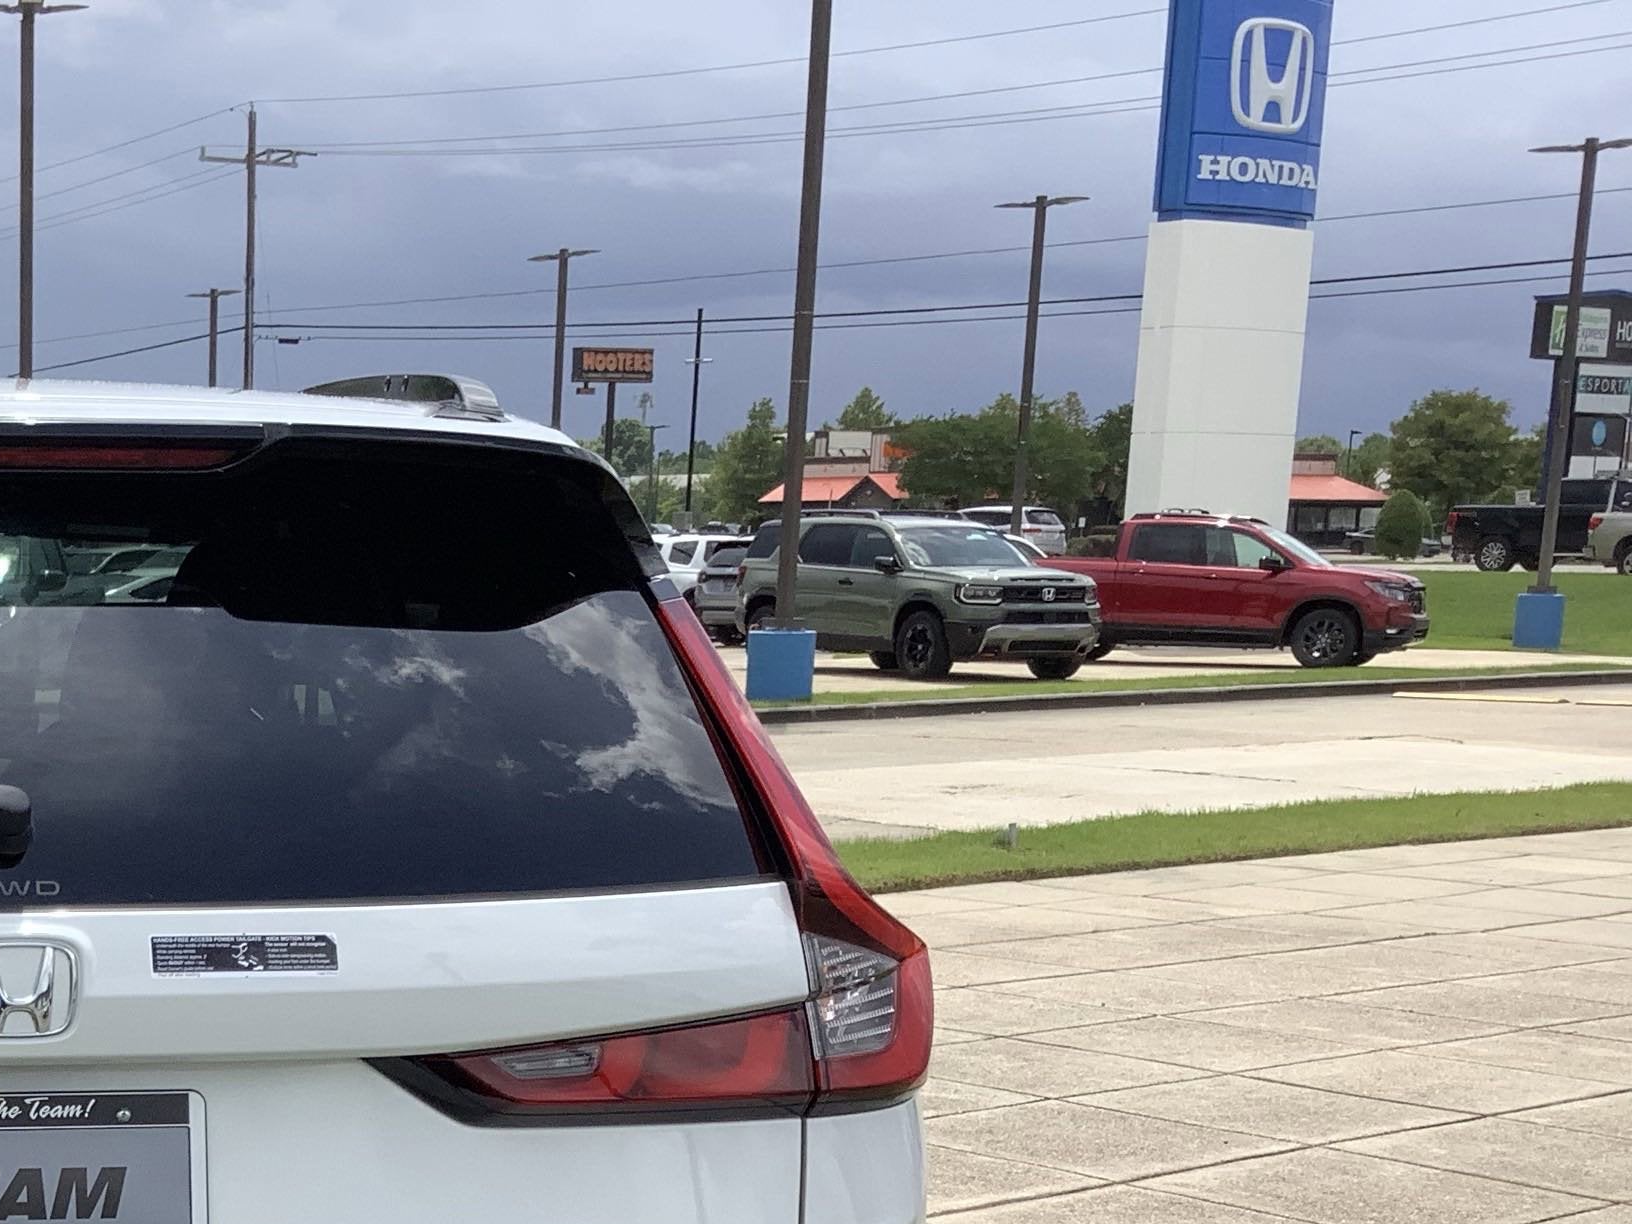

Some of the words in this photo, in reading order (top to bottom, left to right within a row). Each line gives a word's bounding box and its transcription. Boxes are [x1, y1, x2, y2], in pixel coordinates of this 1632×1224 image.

[1197, 155, 1317, 190] HONDA
[582, 351, 652, 372] HOOTERS
[25, 1098, 95, 1120] Team!
